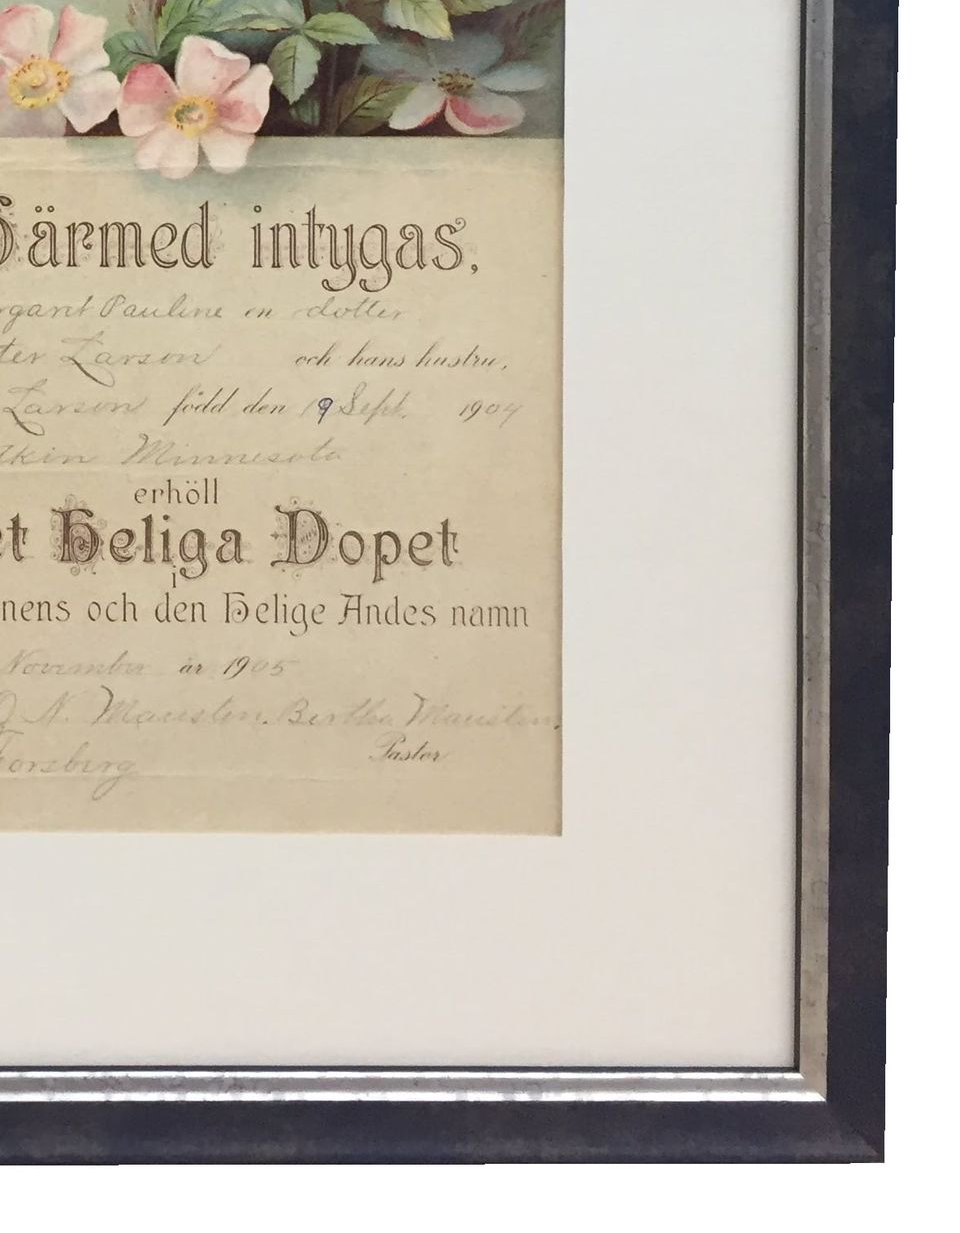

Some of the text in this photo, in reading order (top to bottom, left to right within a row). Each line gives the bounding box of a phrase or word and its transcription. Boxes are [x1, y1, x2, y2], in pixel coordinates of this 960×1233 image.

[251, 203, 480, 293] intygas,
[244, 306, 273, 320] en
[294, 341, 340, 367] och
[347, 338, 406, 368] hans
[162, 383, 239, 427] född
[242, 387, 286, 416] den
[121, 433, 342, 468] Minnesota
[133, 478, 219, 507] erhöll
[271, 502, 460, 583] Dopet
[87, 590, 139, 625] och
[154, 590, 208, 625] den
[224, 590, 327, 637] Helige
[338, 591, 437, 627] Andes
[451, 603, 530, 629] namn
[369, 730, 448, 763] Pastor
